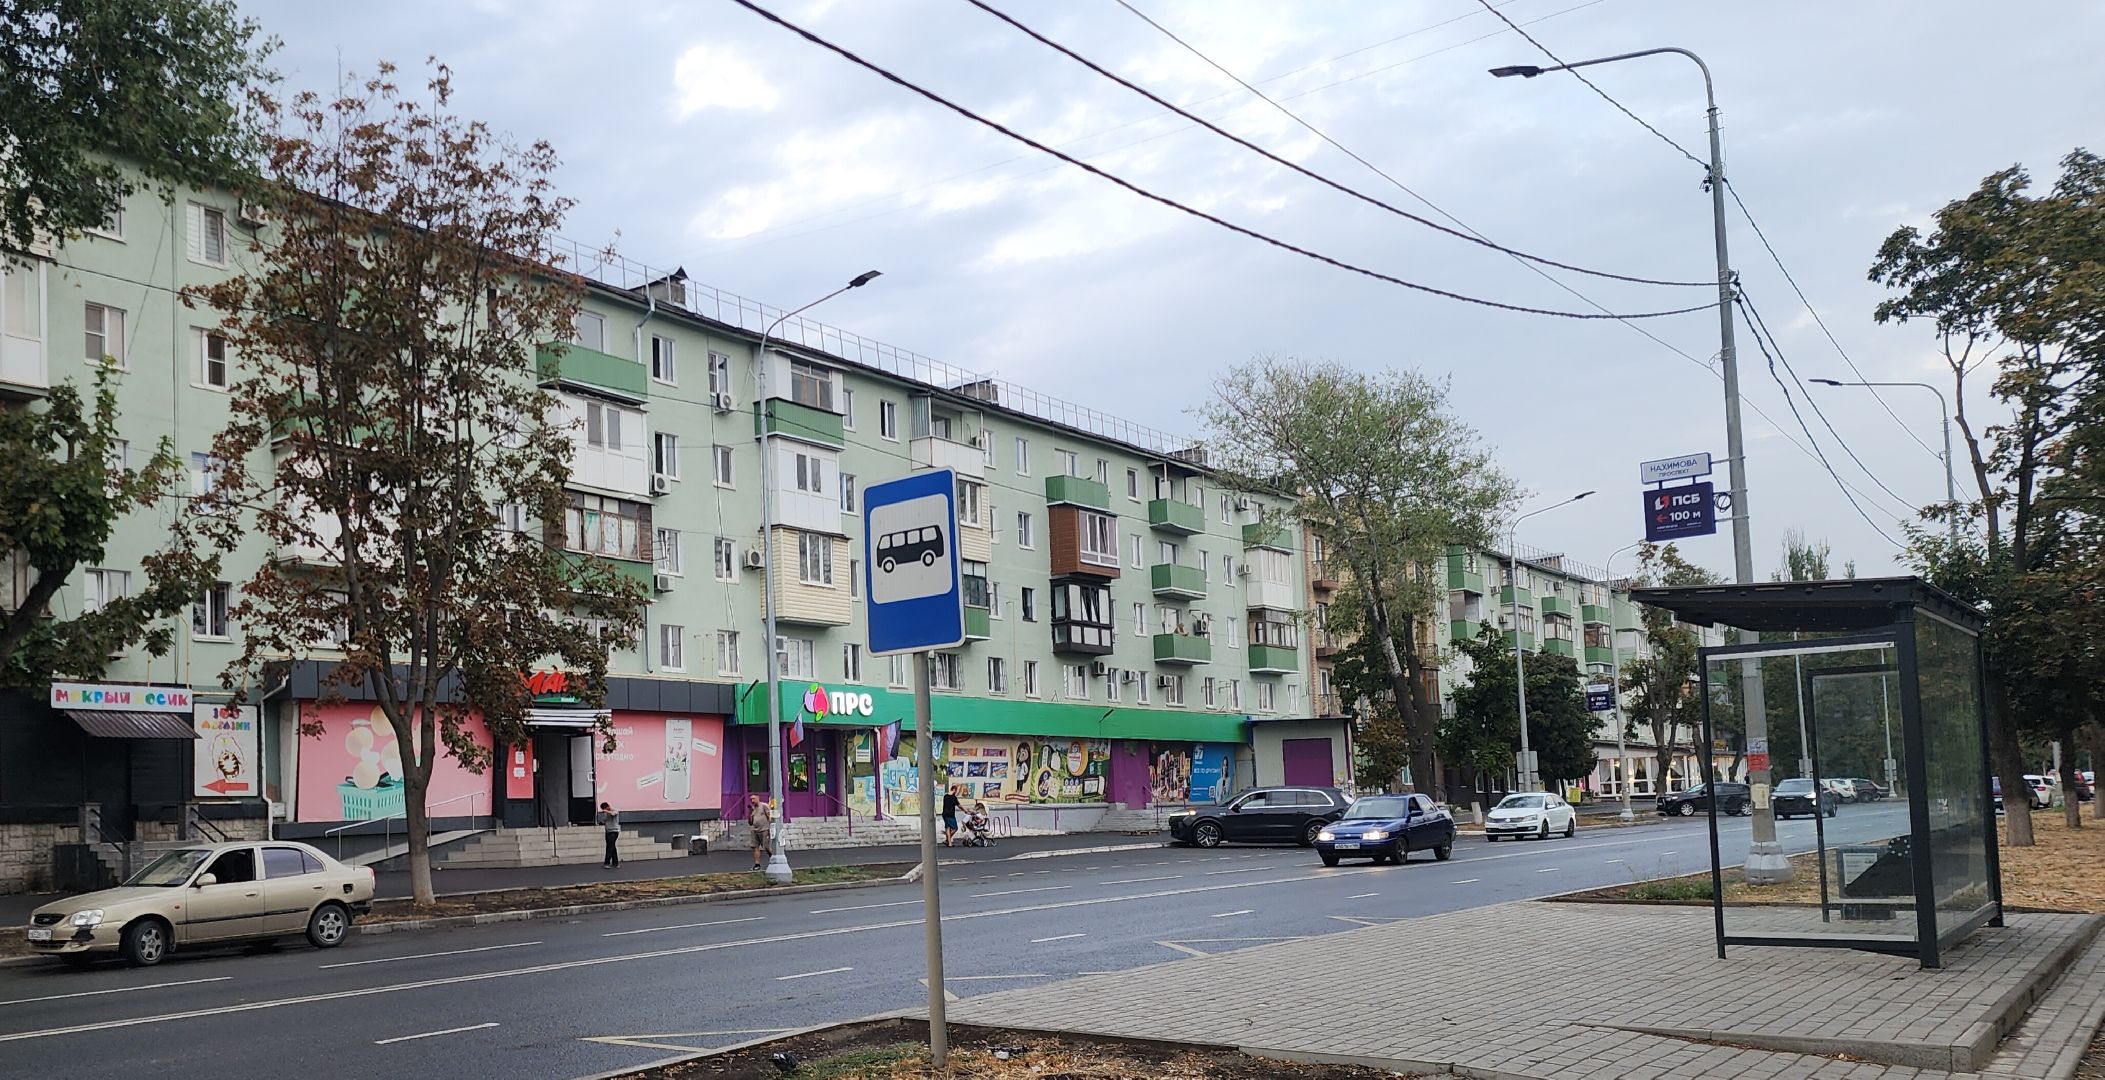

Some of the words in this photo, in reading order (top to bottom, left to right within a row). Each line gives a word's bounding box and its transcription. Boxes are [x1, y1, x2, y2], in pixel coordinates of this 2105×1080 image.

[1650, 459, 1698, 473] НАХИМОВА
[1659, 468, 1690, 478] ПРОСПЕКТ
[1672, 493, 1701, 507] ПСБ
[1669, 510, 1690, 522] 100
[55, 688, 131, 705] МОКРЫЙ
[829, 691, 874, 717] ПРС
